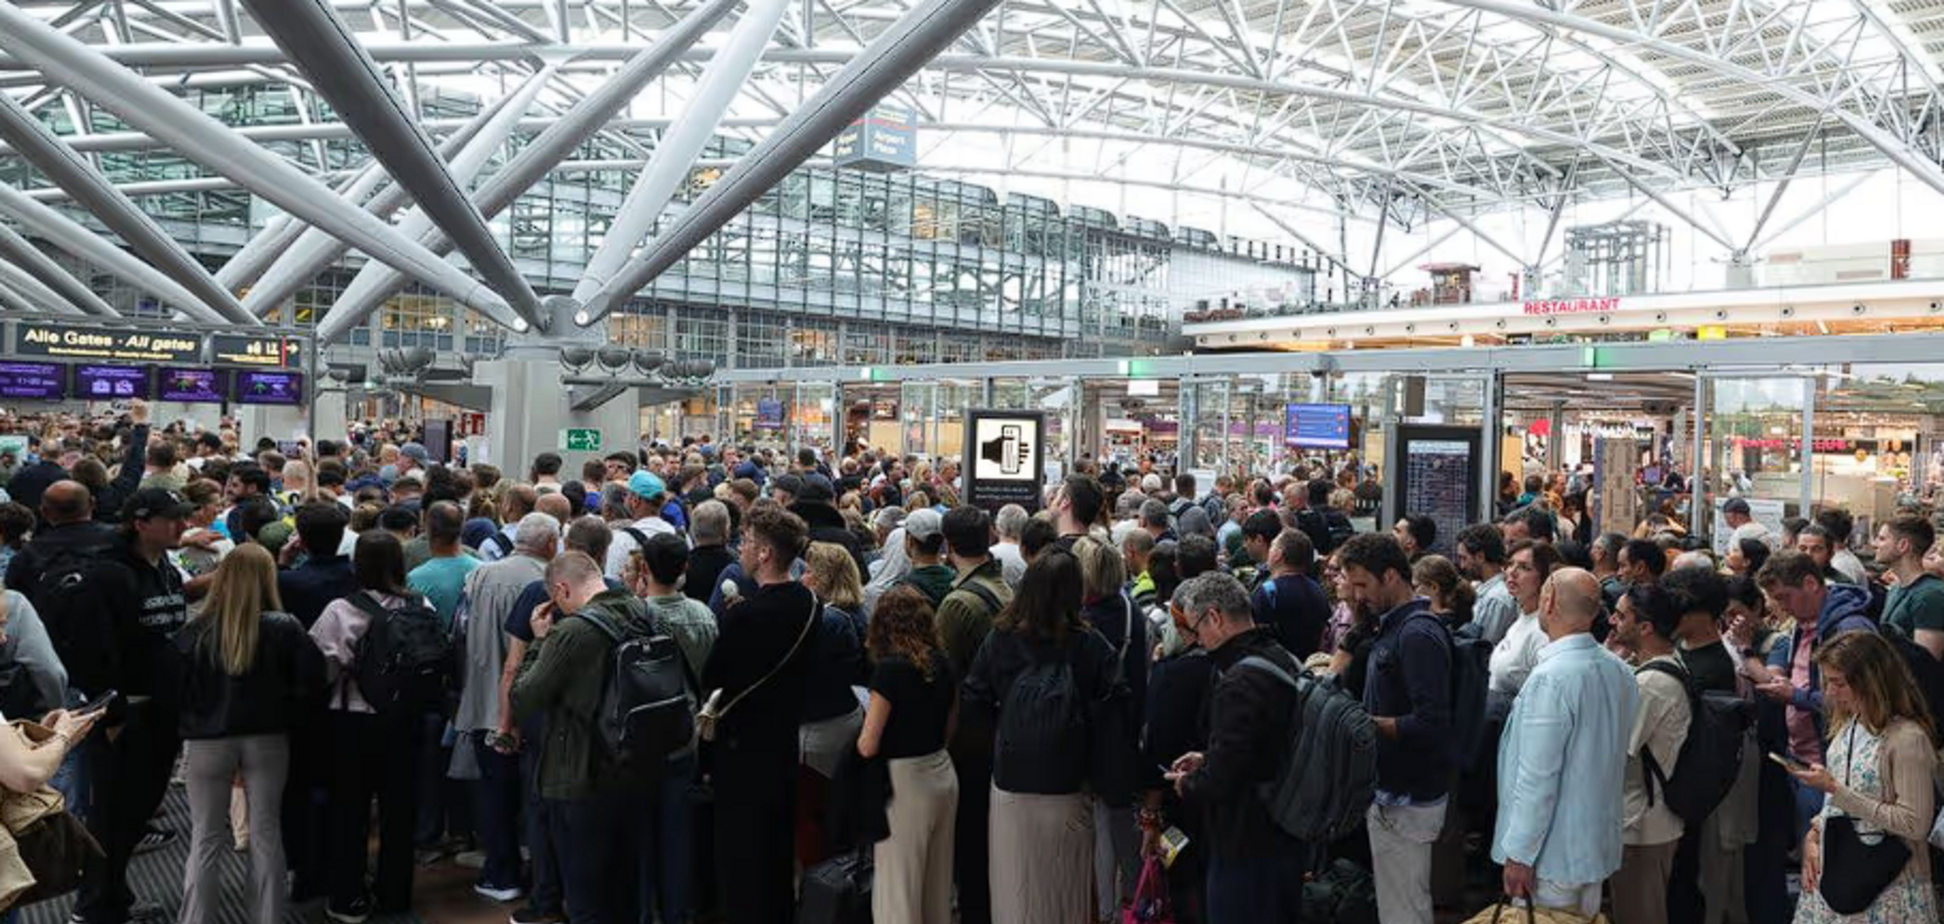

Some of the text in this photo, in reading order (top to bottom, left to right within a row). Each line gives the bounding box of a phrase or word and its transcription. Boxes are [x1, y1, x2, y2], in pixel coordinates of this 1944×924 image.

[1524, 298, 1620, 315] RESTAURANT
[25, 328, 196, 352] Alle Gates All gates
